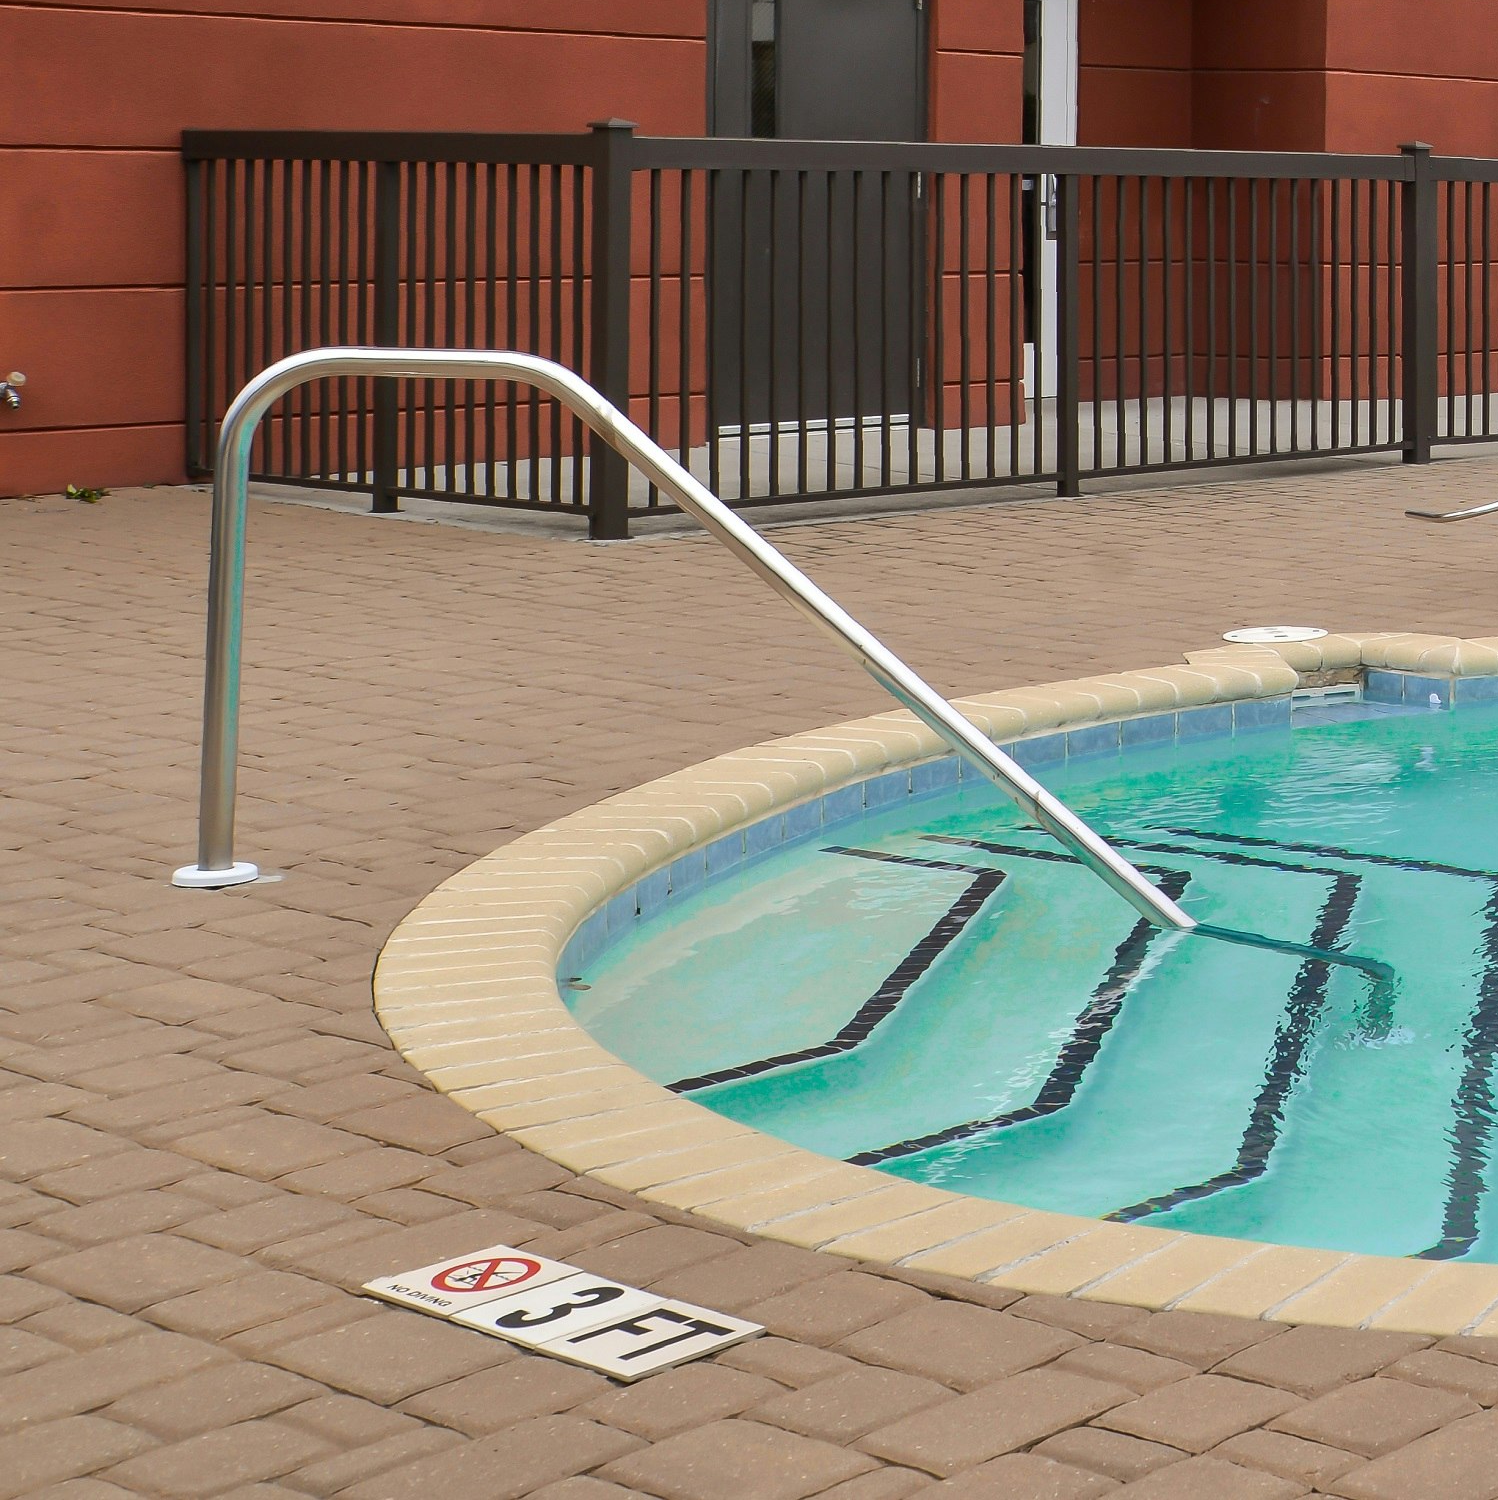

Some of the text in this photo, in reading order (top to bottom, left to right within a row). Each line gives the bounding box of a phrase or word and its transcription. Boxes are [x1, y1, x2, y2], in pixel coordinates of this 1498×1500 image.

[386, 1284, 453, 1307] NO DIVING
[495, 1286, 737, 1361] 3 FT
